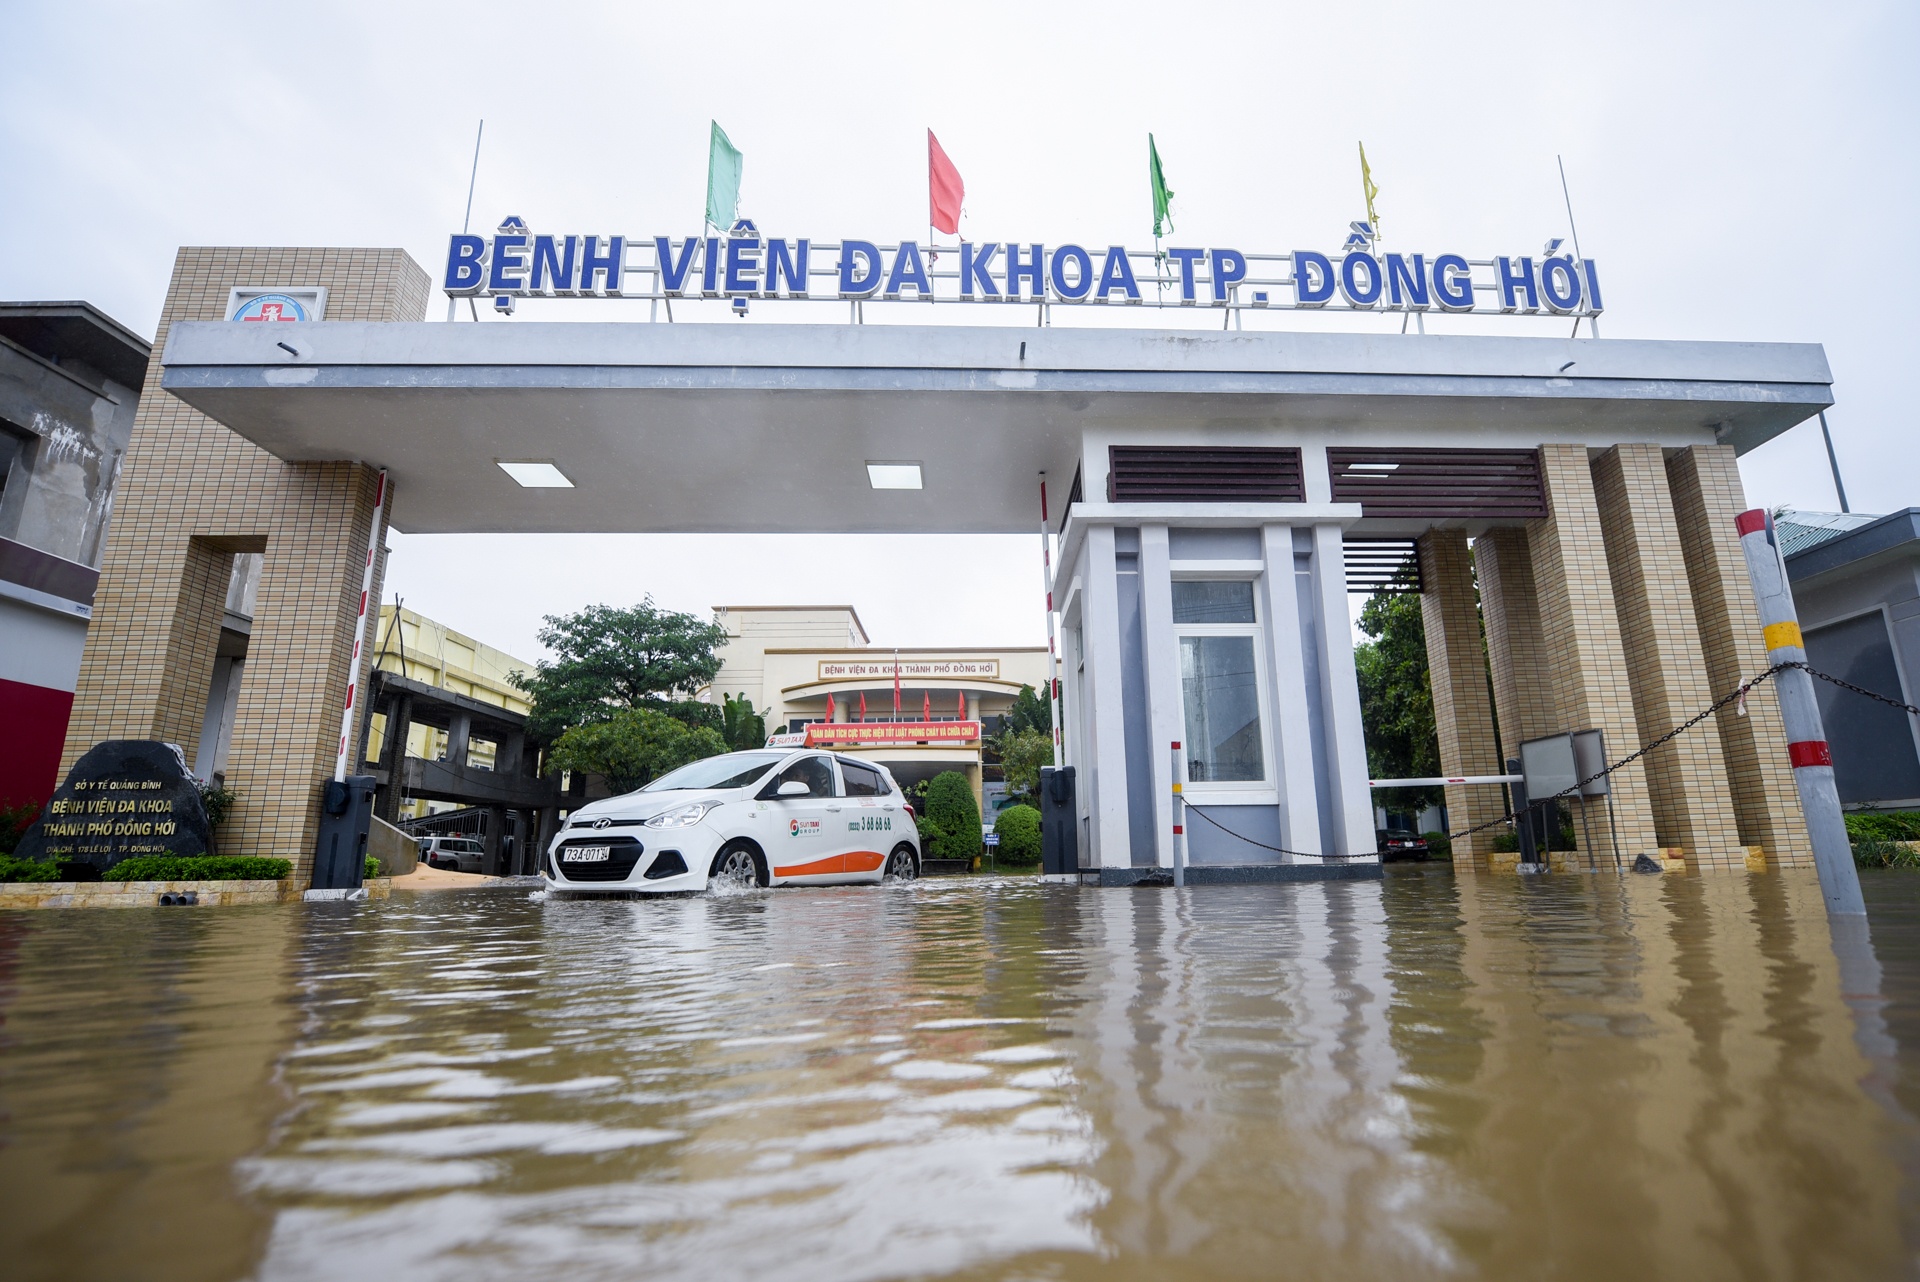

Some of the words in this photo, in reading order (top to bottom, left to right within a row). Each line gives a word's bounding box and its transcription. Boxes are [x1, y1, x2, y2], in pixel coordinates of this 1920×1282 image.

[443, 215, 628, 314] BỆNH
[653, 218, 811, 314] VIỆN
[835, 239, 934, 301] ĐA
[959, 241, 1143, 304] KHOA
[1166, 247, 1269, 308] TP.
[1290, 220, 1476, 313] ĐỒNG
[1493, 237, 1604, 318] HỚI
[825, 665, 845, 675] BỆNH
[849, 664, 866, 675] VIỆN
[869, 666, 879, 674] ĐA
[906, 663, 931, 673] THÀNH
[934, 662, 950, 673] PHỐ
[953, 662, 976, 673] ĐỒNG
[836, 728, 847, 738] TÍCH
[895, 726, 907, 739] LUẬT
[908, 726, 925, 737] PHÒNG
[926, 726, 939, 736] CHÁY
[940, 726, 947, 736] VÀ
[947, 726, 960, 736] CHỮA
[961, 726, 975, 736] CHÁY
[74, 779, 87, 790] SỞ
[89, 782, 96, 790] Y
[97, 778, 109, 790] TẾ
[110, 779, 140, 790] QUẢNG
[141, 779, 162, 790] BÌNH
[51, 798, 85, 817] BỆNH
[87, 797, 117, 816] VIỆN
[117, 800, 136, 813] ĐA
[138, 800, 174, 813] KHOA
[43, 821, 84, 836] THÀNH
[86, 818, 116, 836] PHỐ
[115, 819, 152, 836] ĐỒNG
[154, 819, 176, 836] HỚI
